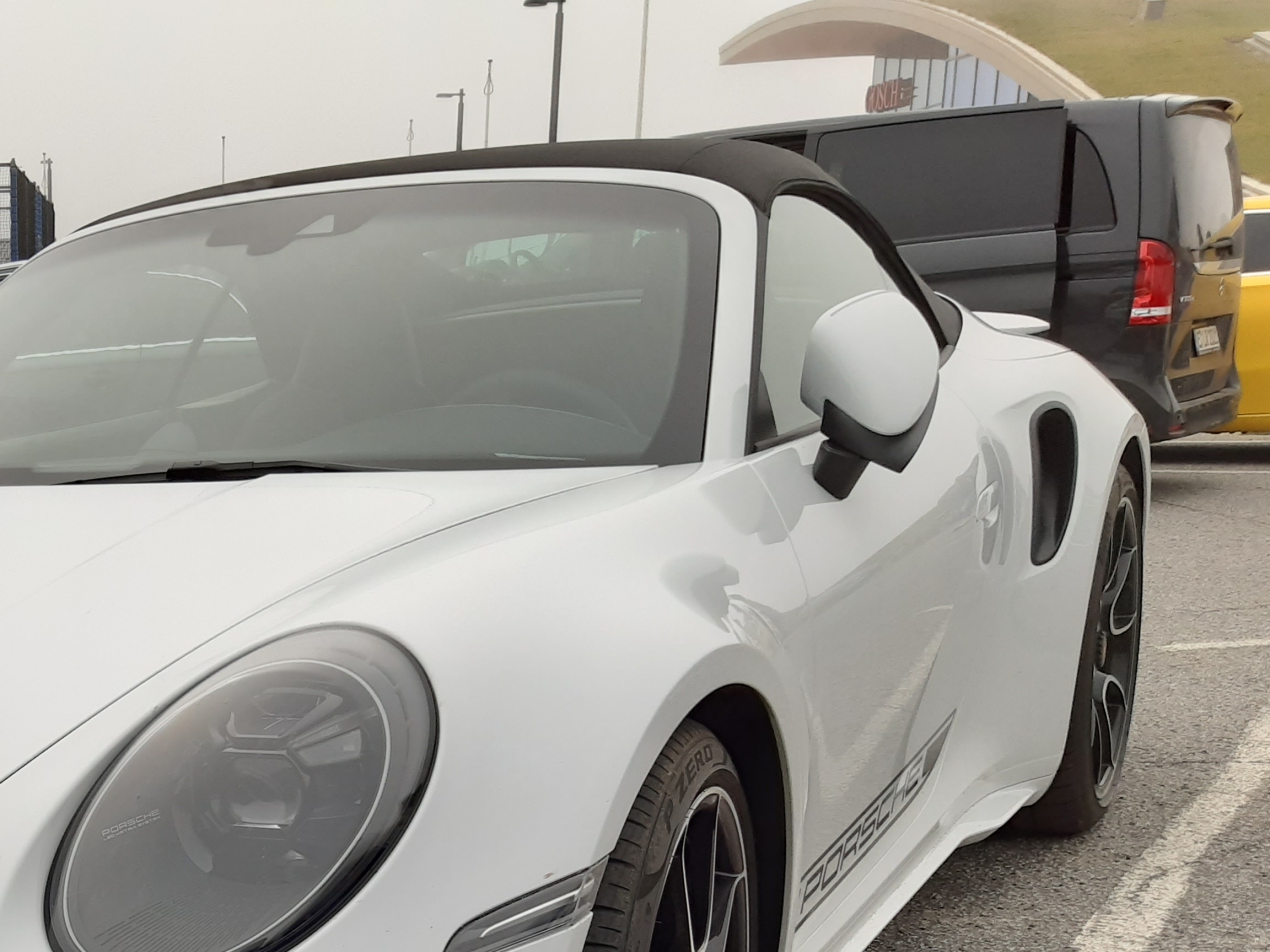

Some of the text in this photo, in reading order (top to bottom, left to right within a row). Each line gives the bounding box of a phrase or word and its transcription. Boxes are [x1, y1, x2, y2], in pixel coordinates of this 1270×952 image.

[675, 743, 714, 805] ZERO
[101, 808, 160, 837] PORSCHE
[799, 755, 923, 915] PORSCHE
